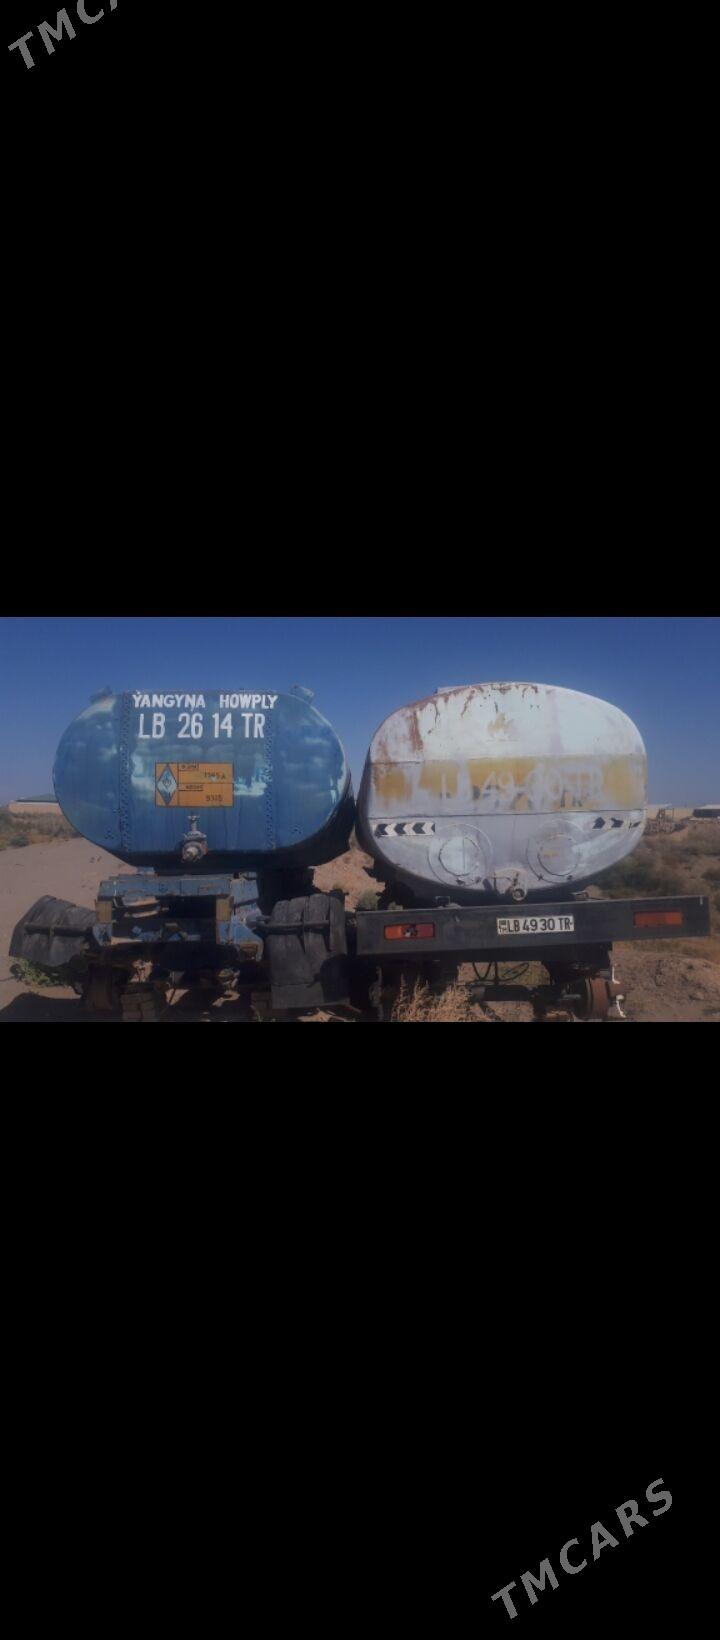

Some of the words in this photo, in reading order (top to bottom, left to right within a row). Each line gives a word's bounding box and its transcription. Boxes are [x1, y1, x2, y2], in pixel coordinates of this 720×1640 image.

[219, 693, 279, 709] HOWPLY
[138, 713, 166, 739] LB
[177, 713, 204, 739] 26
[212, 712, 233, 739] 14
[241, 713, 266, 739] TR
[507, 919, 520, 933] LB
[558, 917, 571, 931] TR
